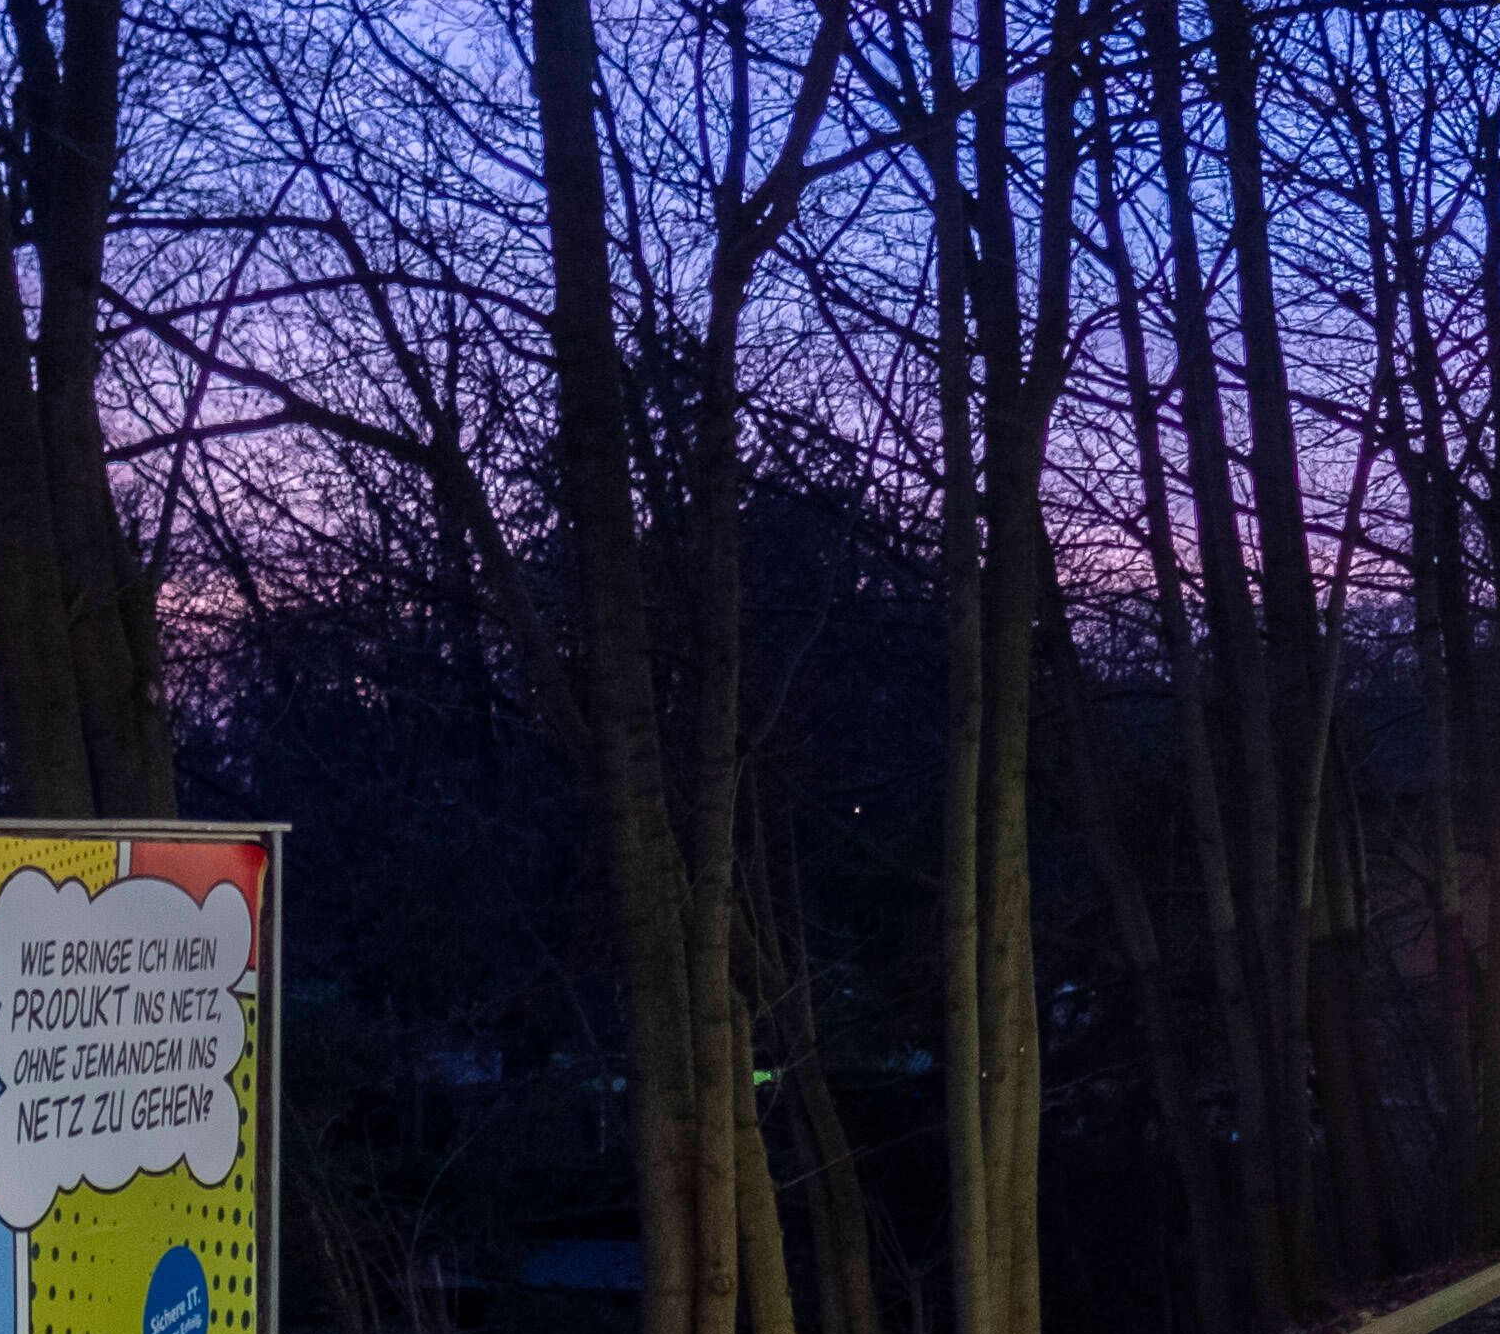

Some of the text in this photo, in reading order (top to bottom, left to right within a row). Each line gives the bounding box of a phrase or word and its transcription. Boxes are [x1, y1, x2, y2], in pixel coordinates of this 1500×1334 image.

[21, 937, 217, 976] WIE BRINGE ICH MEIN
[11, 984, 222, 1033] PRODUKT INS NETZ,
[13, 1036, 217, 1085] OHNE JEMANDEM INS
[16, 1083, 214, 1144] NETZ ZU GEHEN?
